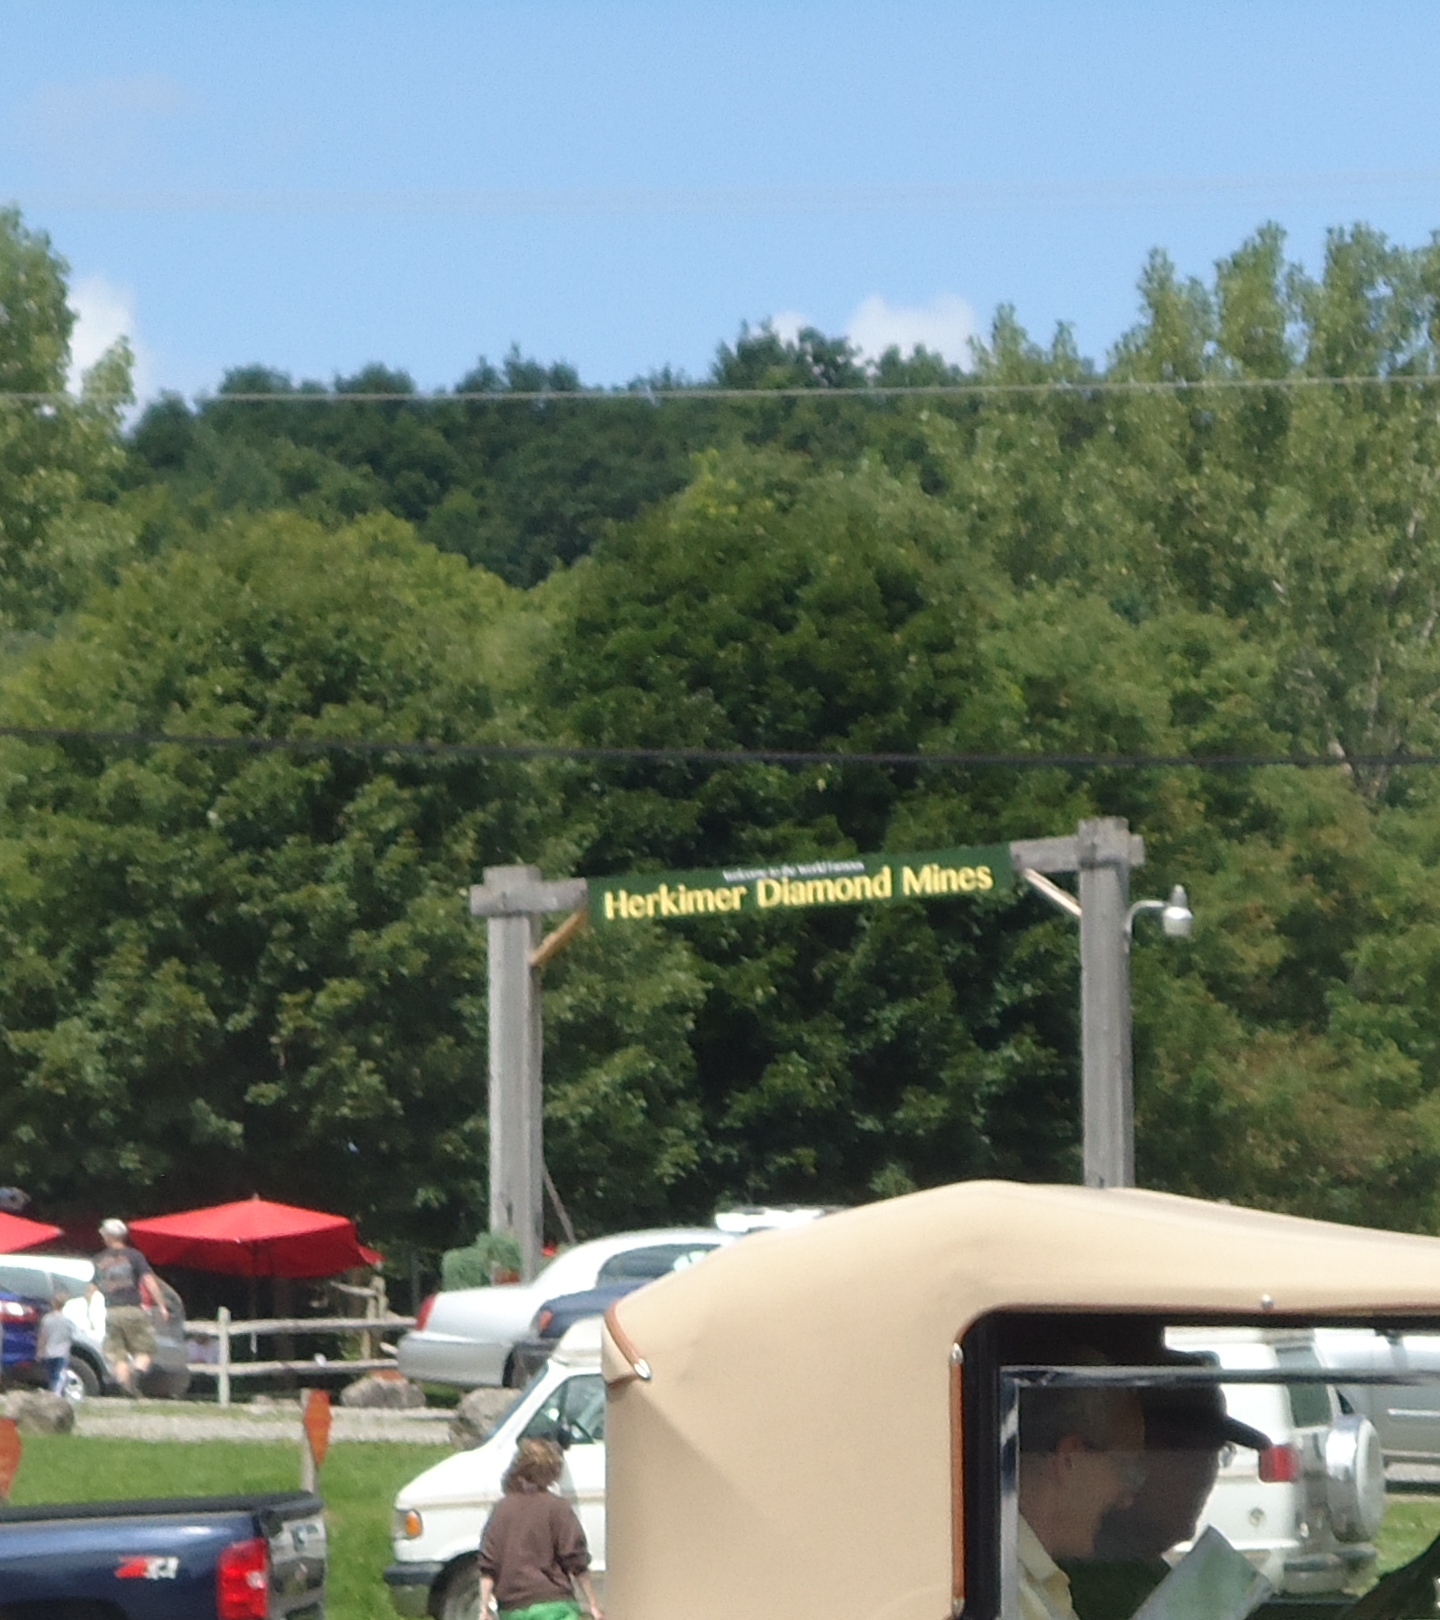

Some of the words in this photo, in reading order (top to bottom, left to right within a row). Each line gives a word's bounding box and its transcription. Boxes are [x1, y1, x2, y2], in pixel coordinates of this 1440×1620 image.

[603, 882, 748, 920] Herkimer
[756, 864, 893, 908] Diamond
[901, 863, 994, 896] Mines
